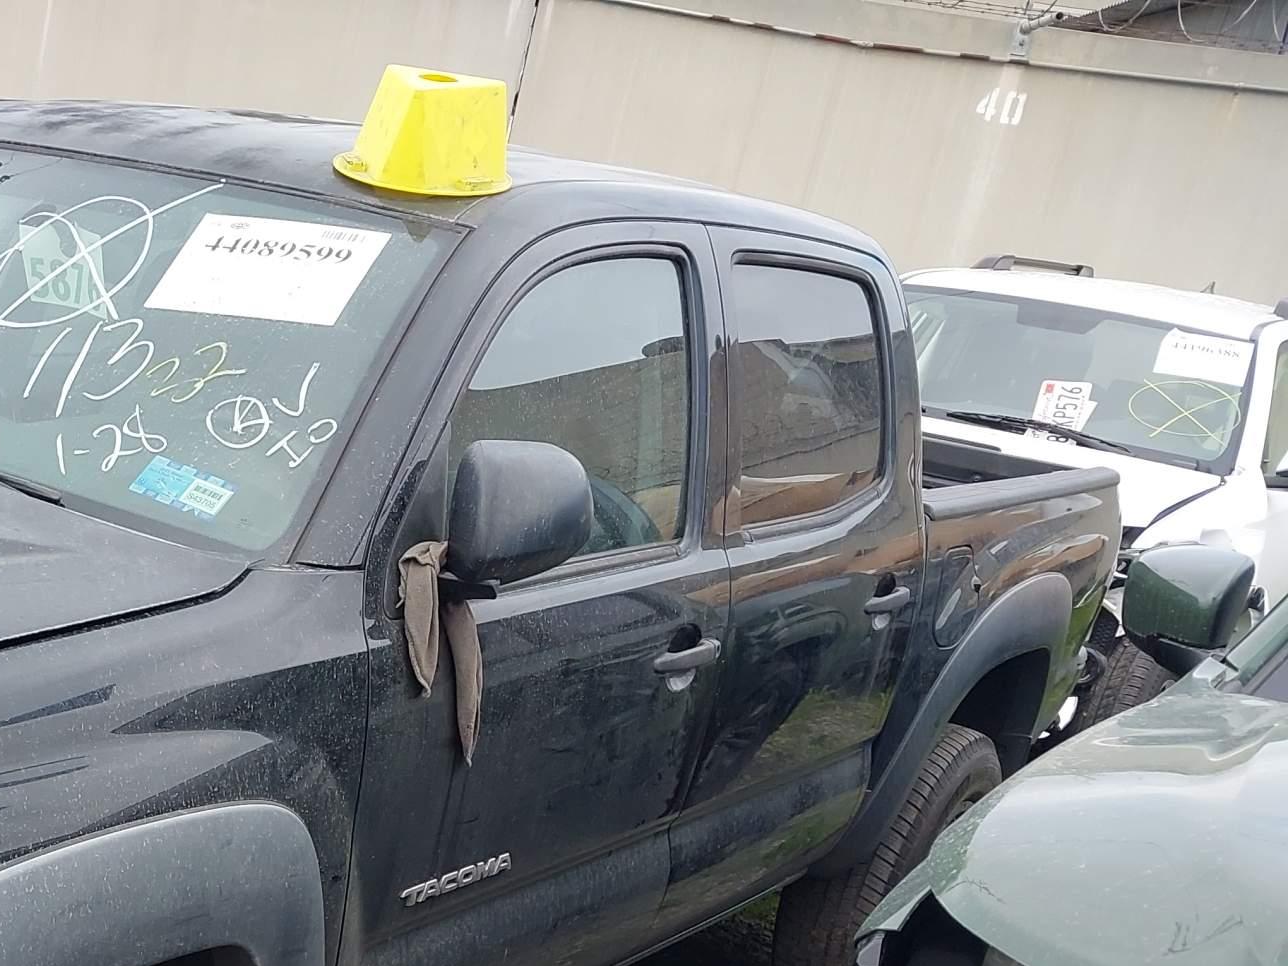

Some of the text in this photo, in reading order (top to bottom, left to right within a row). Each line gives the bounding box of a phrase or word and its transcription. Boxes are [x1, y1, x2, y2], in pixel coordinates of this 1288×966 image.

[976, 87, 1027, 125] 40
[205, 235, 353, 264] 44089599
[399, 852, 511, 907] TACOMA
